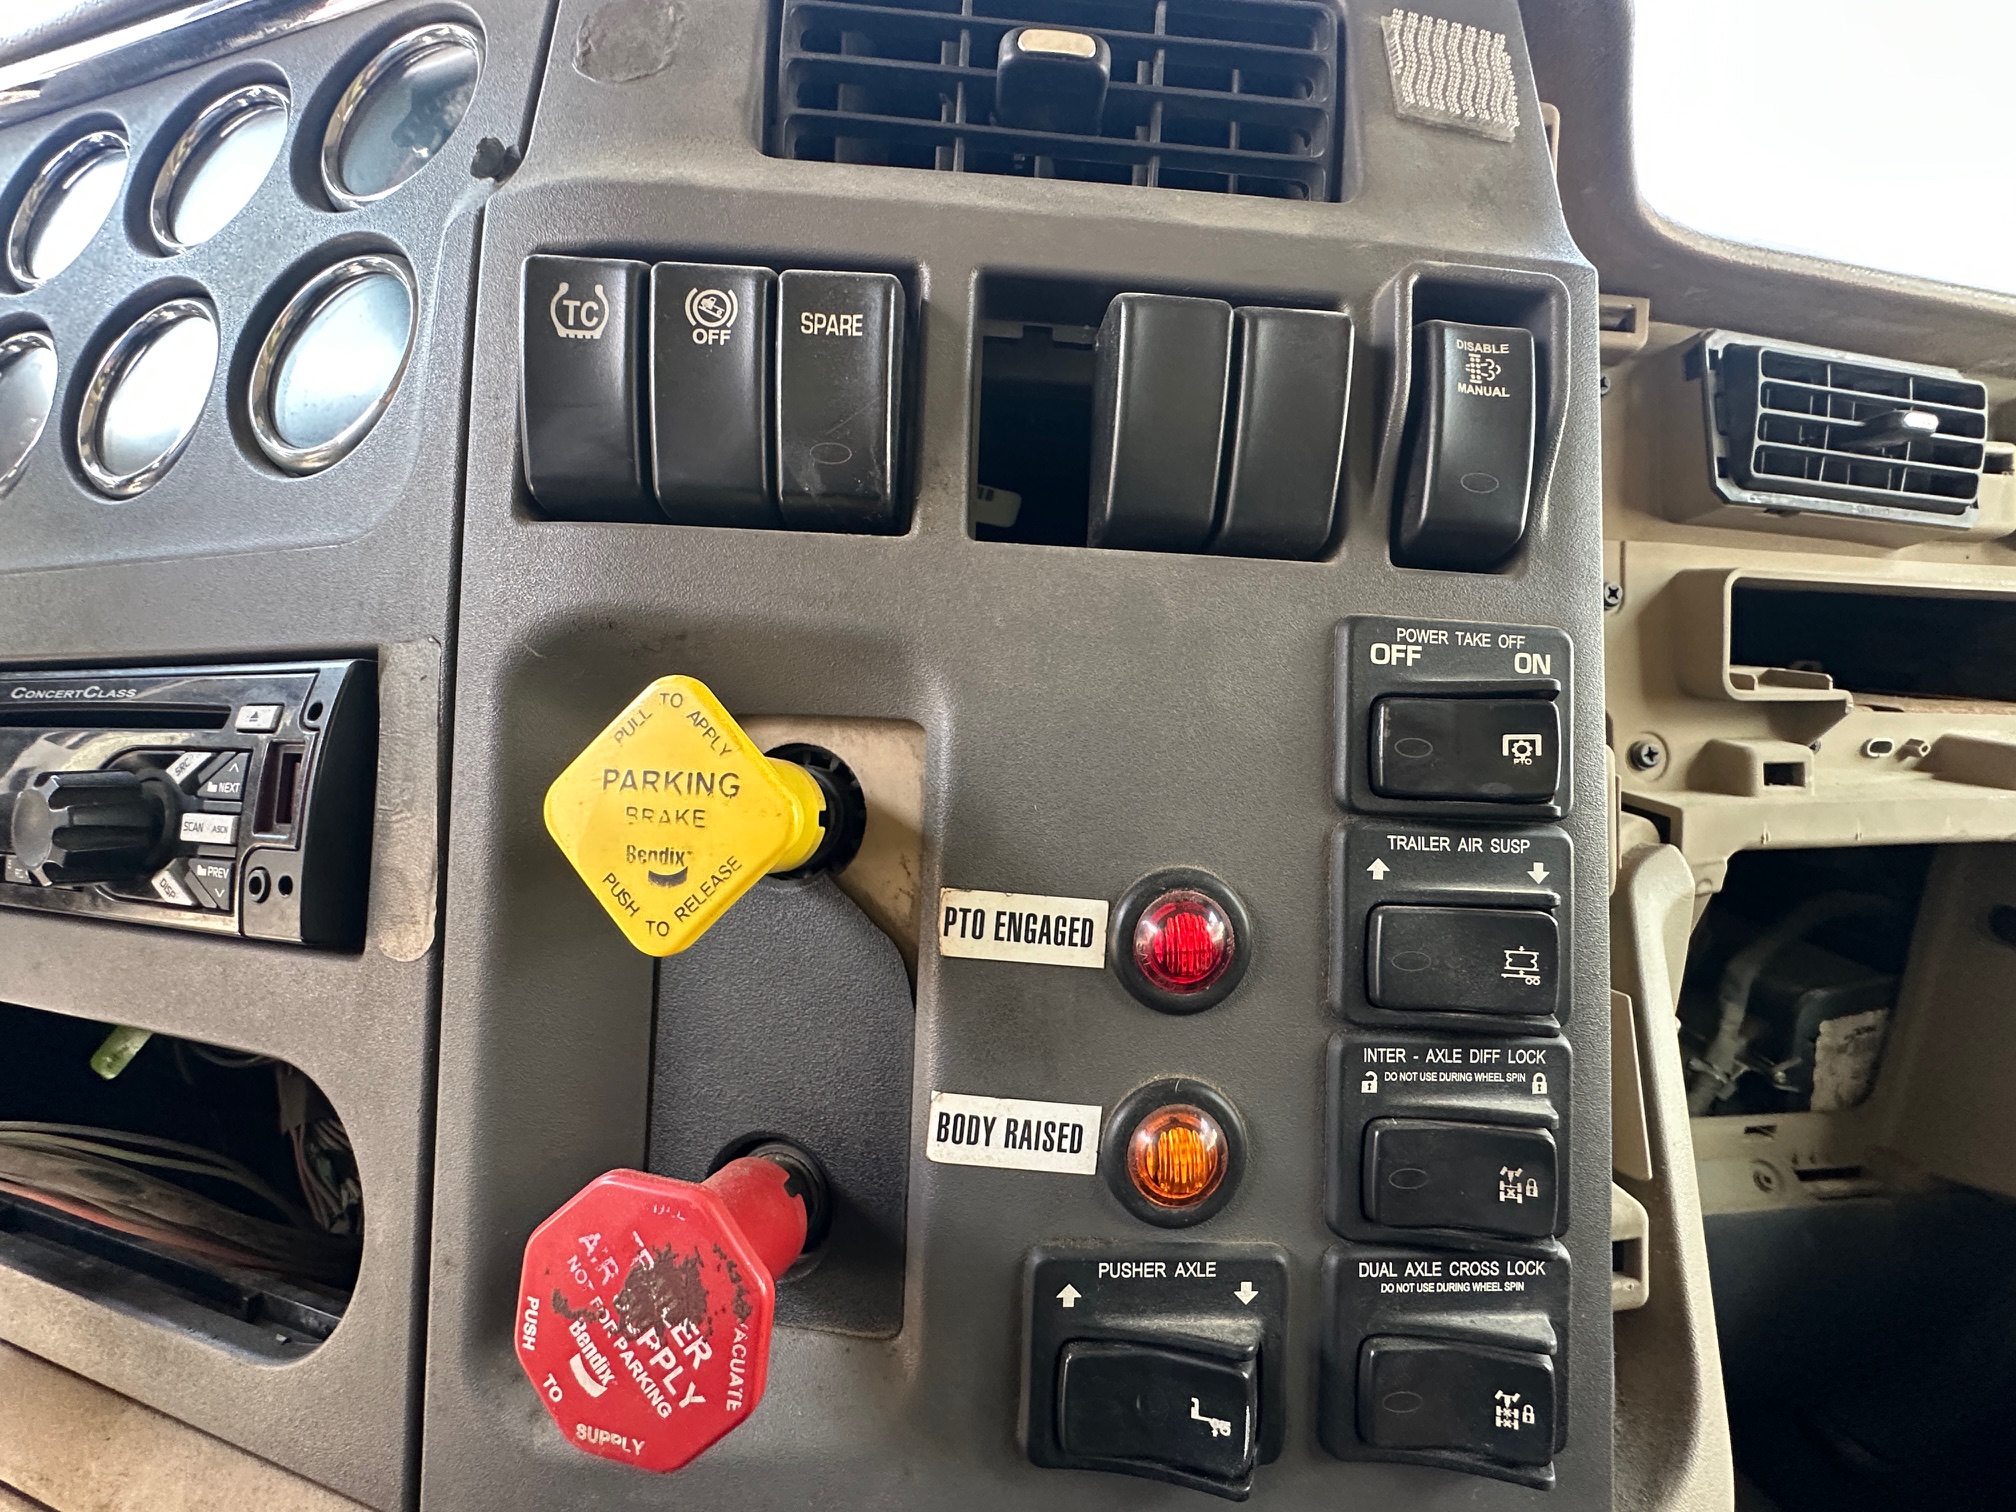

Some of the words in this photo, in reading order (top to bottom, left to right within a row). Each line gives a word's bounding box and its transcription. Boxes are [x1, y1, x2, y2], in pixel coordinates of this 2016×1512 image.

[563, 299, 600, 327] TC
[800, 311, 864, 337] SPARE
[692, 328, 732, 346] OFF
[1456, 339, 1510, 354] DISABLE
[1457, 382, 1511, 398] MANUAL
[1396, 627, 1449, 645] POWER
[1455, 631, 1492, 648] TAKE
[1498, 635, 1526, 650] OFF
[1370, 643, 1423, 667] OFF
[1514, 652, 1551, 675] ON
[612, 709, 653, 746] PULL
[659, 692, 684, 709] TO
[686, 710, 732, 757] APPLY
[1513, 758, 1533, 766] PTO
[218, 780, 241, 794] NEXT
[602, 768, 741, 799] PARKING
[182, 821, 204, 833] SCAN
[625, 806, 706, 829] BRAKE
[625, 844, 686, 867] Bendix
[1387, 835, 1451, 852] TRAILER
[1457, 838, 1484, 852] AIR
[1490, 838, 1531, 854] SUSP
[207, 866, 230, 879] PREV
[159, 877, 176, 899] DISP
[602, 872, 641, 917] PUSH
[645, 920, 670, 938] TO
[674, 856, 743, 923] RELEASE
[943, 906, 986, 940] PTO
[993, 910, 1094, 949] ENGAGED
[1363, 1048, 1407, 1063] INTER
[1425, 1048, 1463, 1064] AXLE
[1469, 1049, 1501, 1064] DIFF
[1508, 1049, 1547, 1064] LOCK
[1384, 1071, 1398, 1082] DO
[1399, 1071, 1418, 1082] NOT
[1419, 1071, 1438, 1082] USE
[1439, 1072, 1473, 1082] DURING
[1474, 1072, 1505, 1083] WHEEL
[1506, 1072, 1526, 1083] SPIN
[936, 1111, 997, 1147] BODY
[1003, 1117, 1084, 1155] RAISED
[1098, 1262, 1167, 1279] PUSHER
[1174, 1262, 1217, 1278] AXLE
[1358, 1262, 1398, 1278] DUAL
[1404, 1262, 1442, 1277] AXLE
[1449, 1261, 1499, 1277] CROSS
[1507, 1261, 1546, 1276] LOCK
[1381, 1282, 1395, 1293] DO
[1396, 1282, 1415, 1293] NOT
[1416, 1283, 1435, 1292] USE
[1436, 1282, 1471, 1293] DURING
[1472, 1282, 1503, 1292] WHEEL
[1504, 1282, 1525, 1291] SPIN
[567, 1254, 595, 1291] NOT
[613, 1336, 673, 1419] PARKING
[568, 1317, 616, 1387] Bendix
[522, 1296, 540, 1351] PUSH
[541, 1373, 563, 1403] TO
[575, 1423, 645, 1456] SUPPLY
